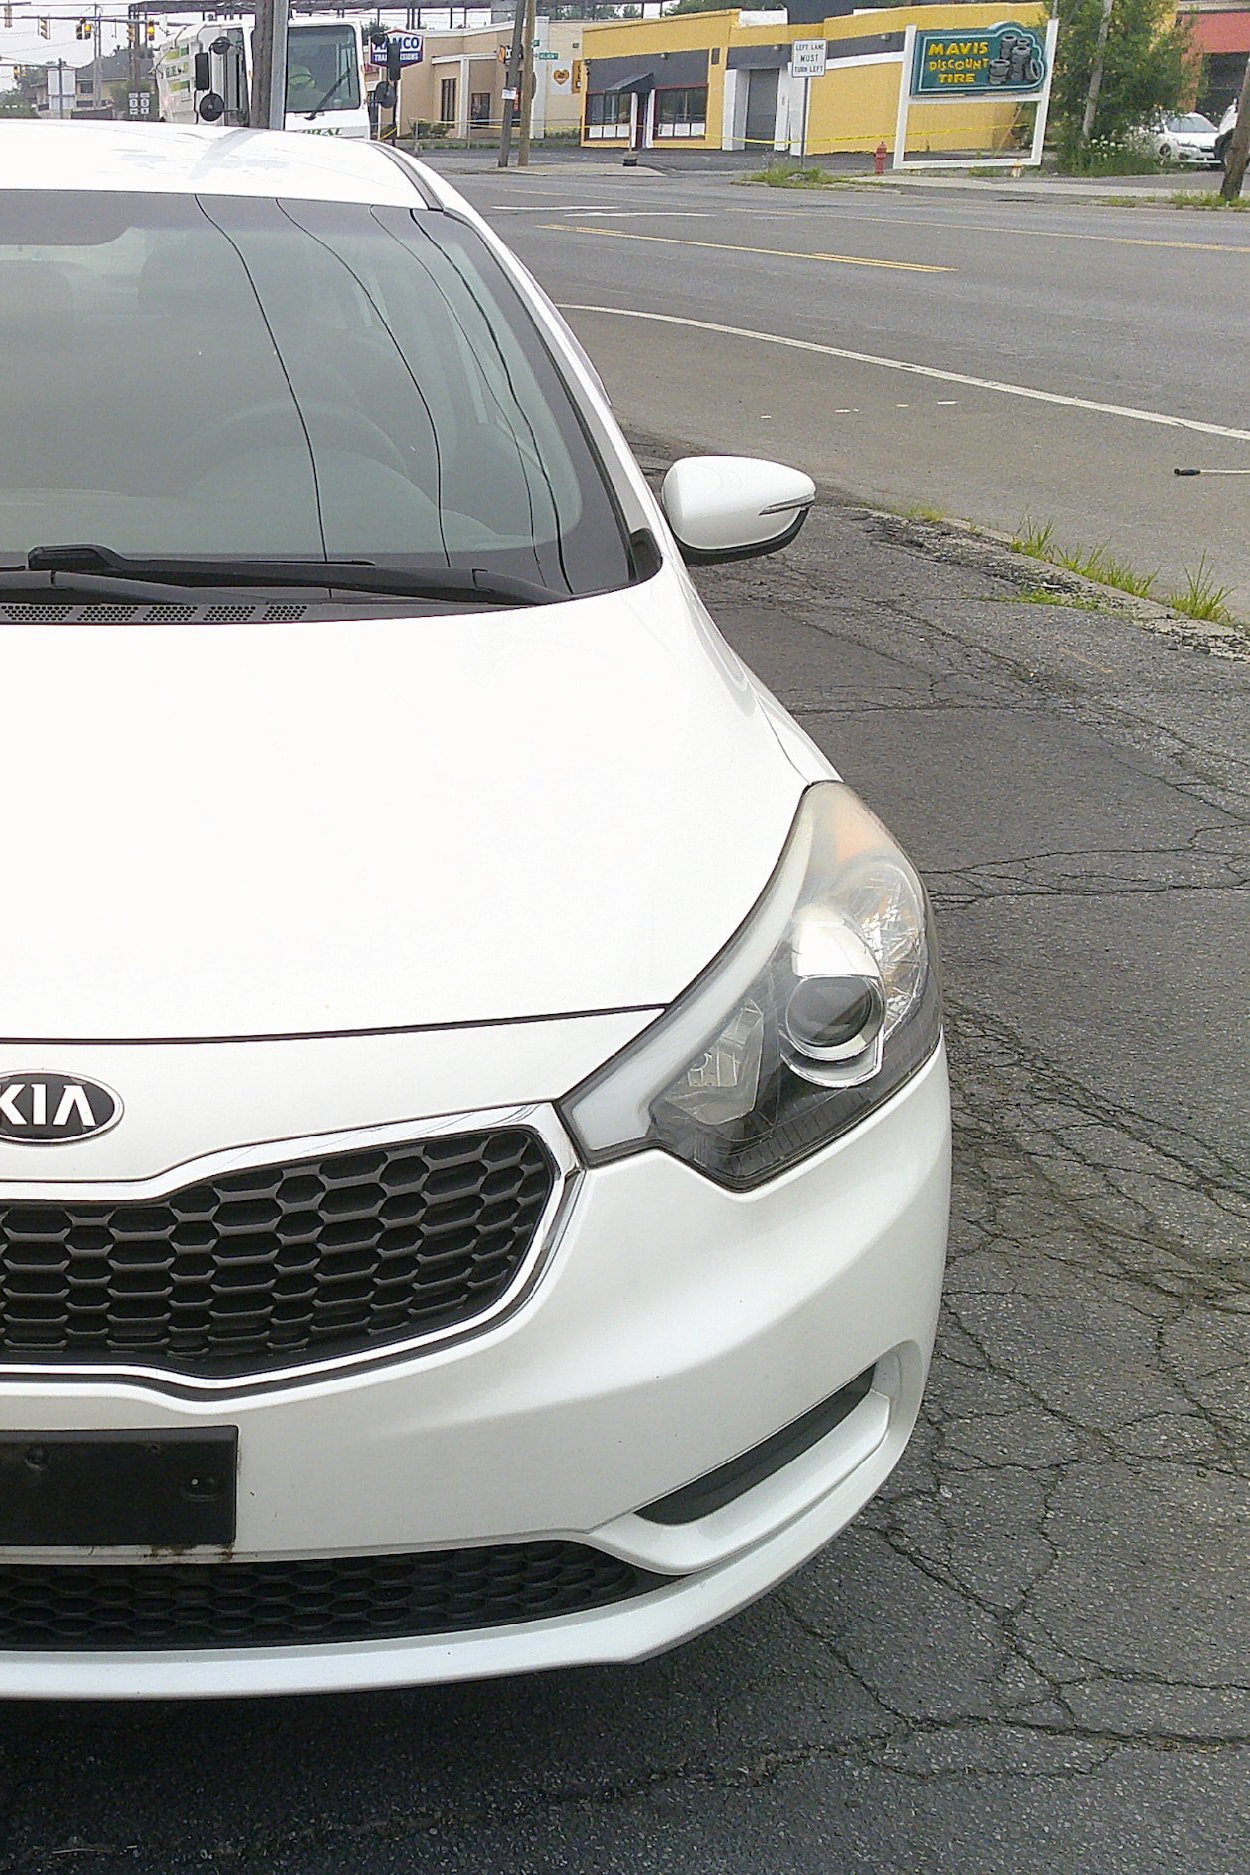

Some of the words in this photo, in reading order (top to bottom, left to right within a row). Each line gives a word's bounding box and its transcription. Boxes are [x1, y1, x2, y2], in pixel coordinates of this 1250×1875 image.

[928, 42, 988, 56] MAVIS
[800, 54, 818, 62] MUST
[809, 65, 823, 73] LEFT
[929, 58, 990, 71] DISCOUNT
[938, 73, 975, 84] TIRE
